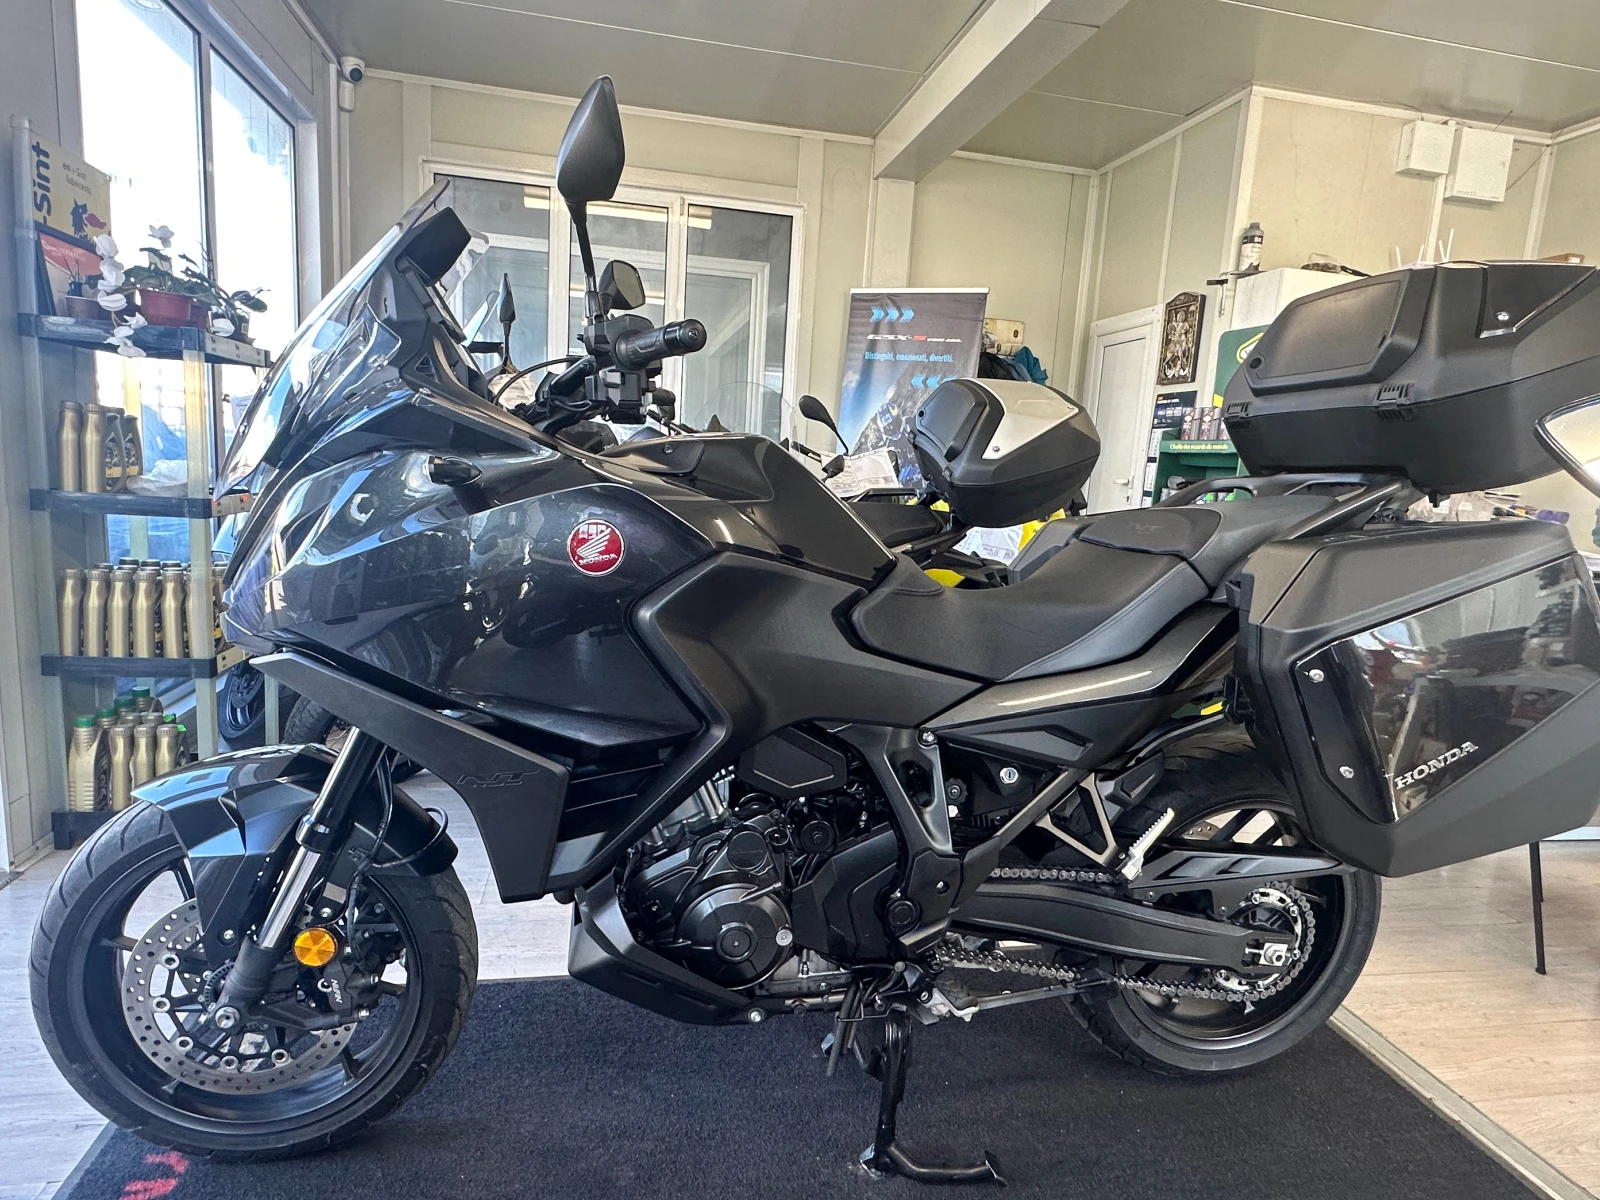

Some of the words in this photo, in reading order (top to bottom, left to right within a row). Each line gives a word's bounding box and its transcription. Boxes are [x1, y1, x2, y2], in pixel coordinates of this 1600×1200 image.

[864, 351, 895, 361] Distinguiti,
[896, 352, 928, 363] emozionati,
[929, 353, 954, 363] divertiti.
[1394, 741, 1479, 790] HONDA
